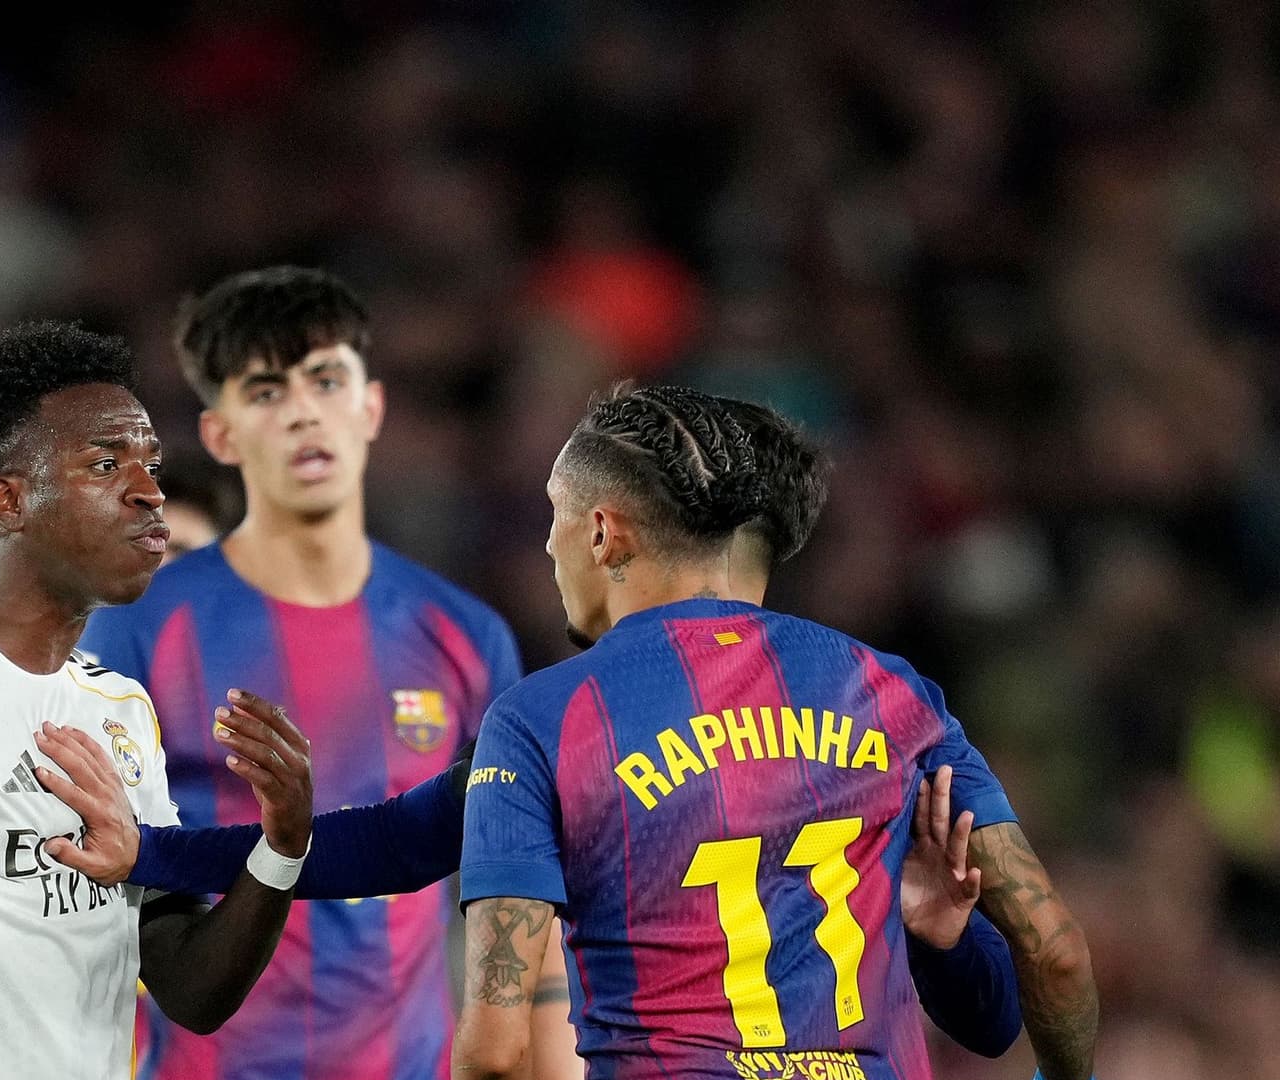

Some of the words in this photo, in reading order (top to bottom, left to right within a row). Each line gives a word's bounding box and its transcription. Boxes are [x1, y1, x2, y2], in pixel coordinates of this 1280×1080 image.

[500, 768, 517, 784] tv
[614, 706, 889, 811] RAPHINHA
[41, 870, 80, 918] FLY
[680, 816, 864, 1049] 11
